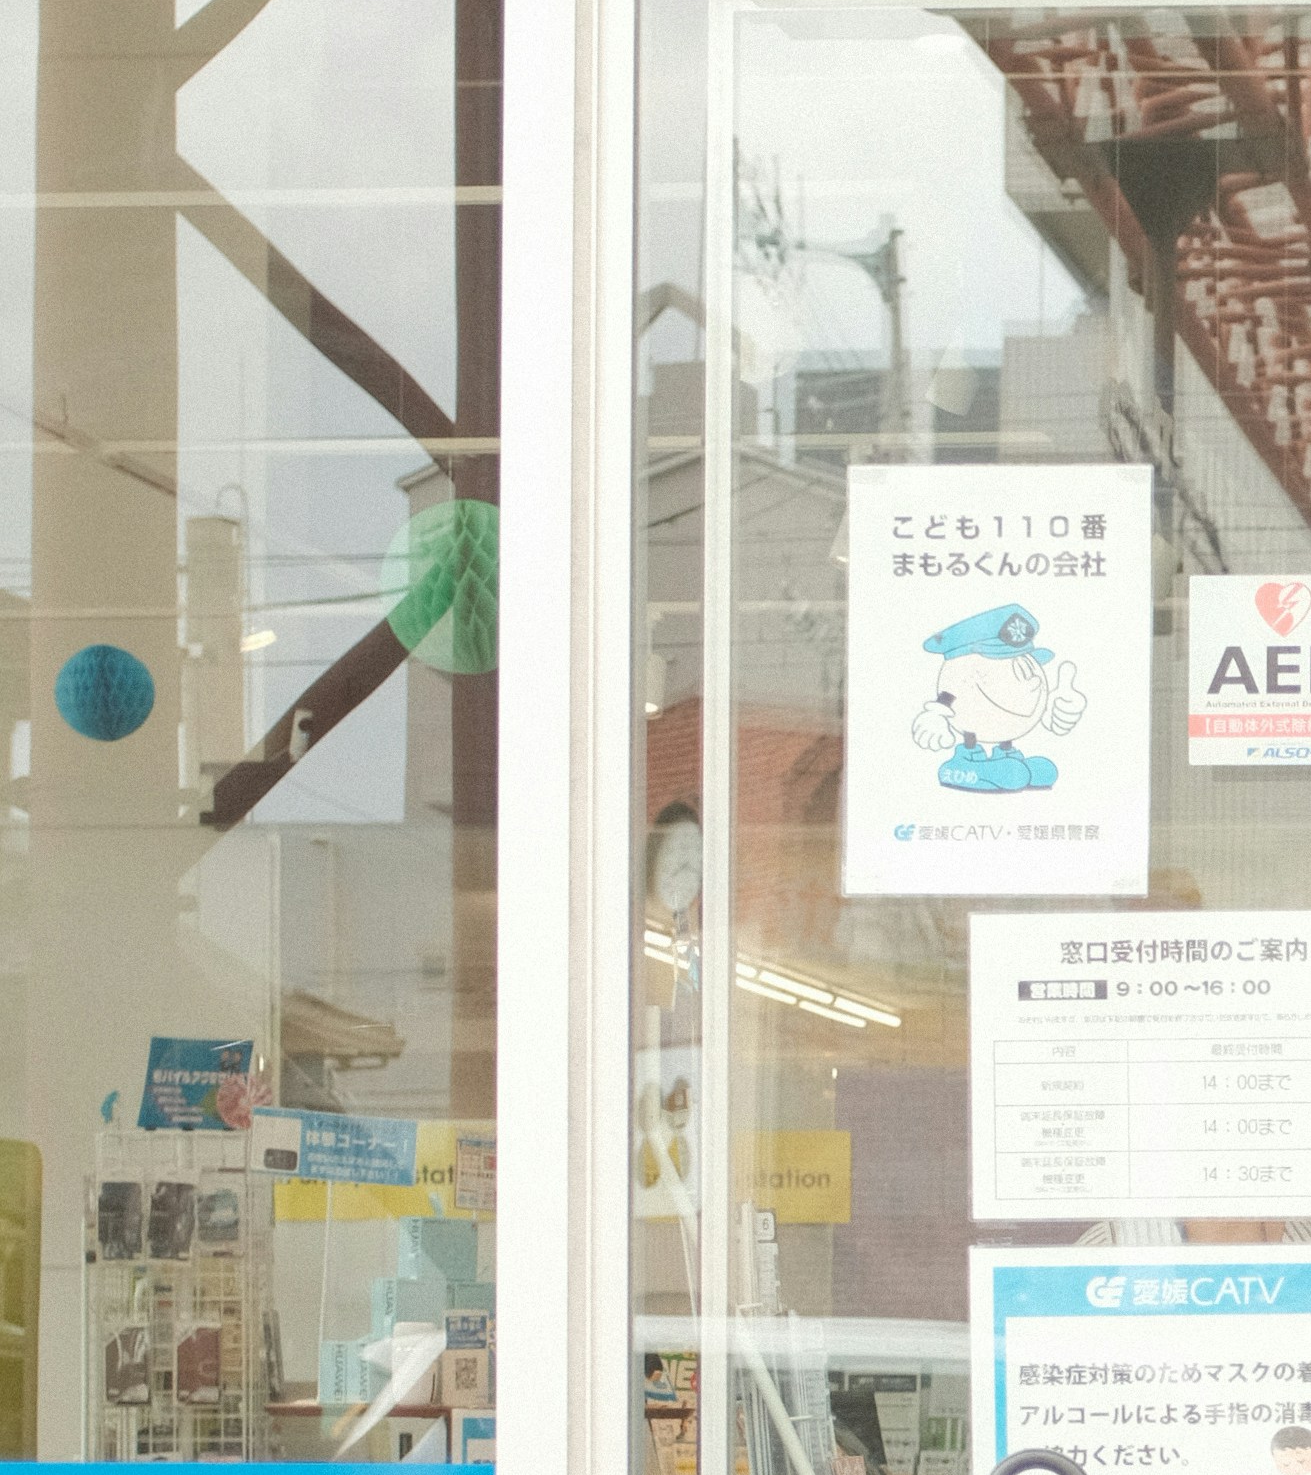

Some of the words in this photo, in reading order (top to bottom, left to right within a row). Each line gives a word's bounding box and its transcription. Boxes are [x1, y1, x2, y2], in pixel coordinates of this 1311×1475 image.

[892, 551, 1107, 577] まもるくんの会社
[1060, 938, 1309, 964] 窓口受付時間のご案内
[1133, 1276, 1285, 1307] 愛媛CATV
